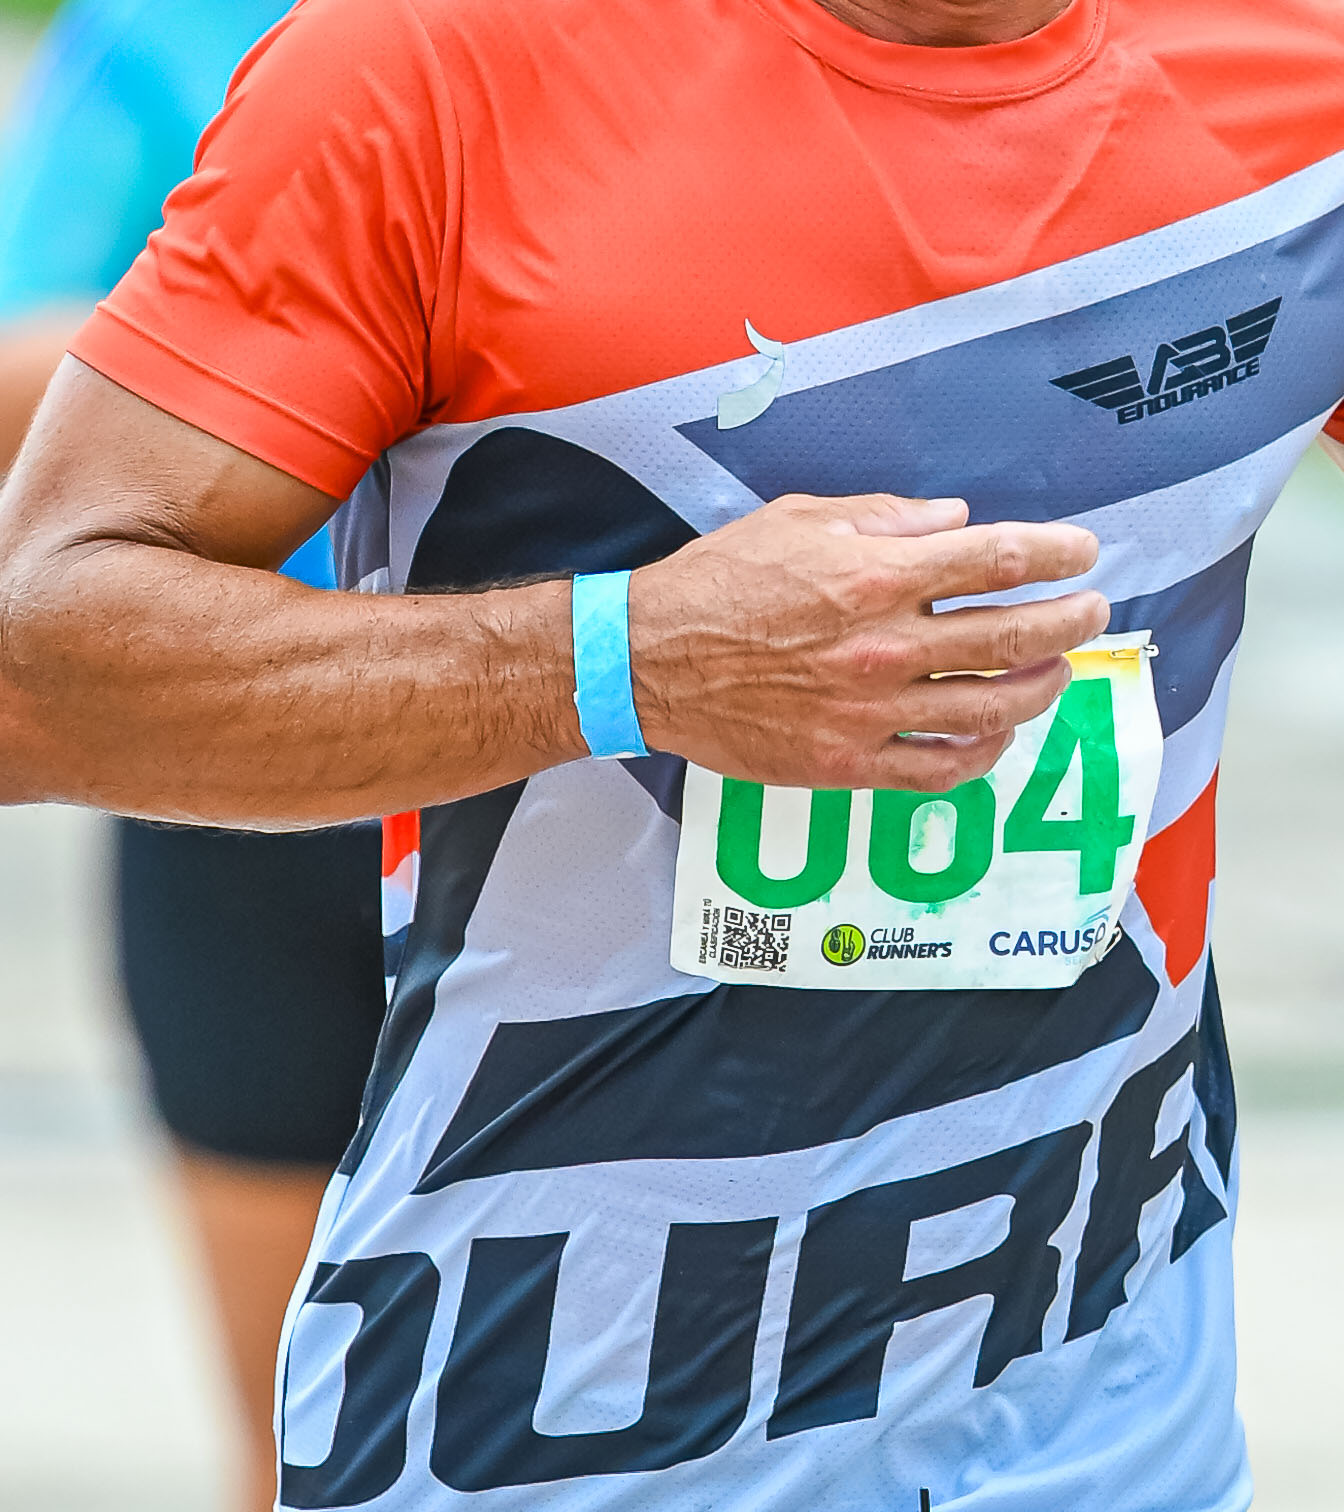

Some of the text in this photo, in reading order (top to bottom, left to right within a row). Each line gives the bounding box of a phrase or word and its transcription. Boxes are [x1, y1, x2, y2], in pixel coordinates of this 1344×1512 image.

[1116, 356, 1261, 425] ENDURANCE
[870, 927, 915, 944] CLUB
[866, 941, 953, 960] RUNNER'S
